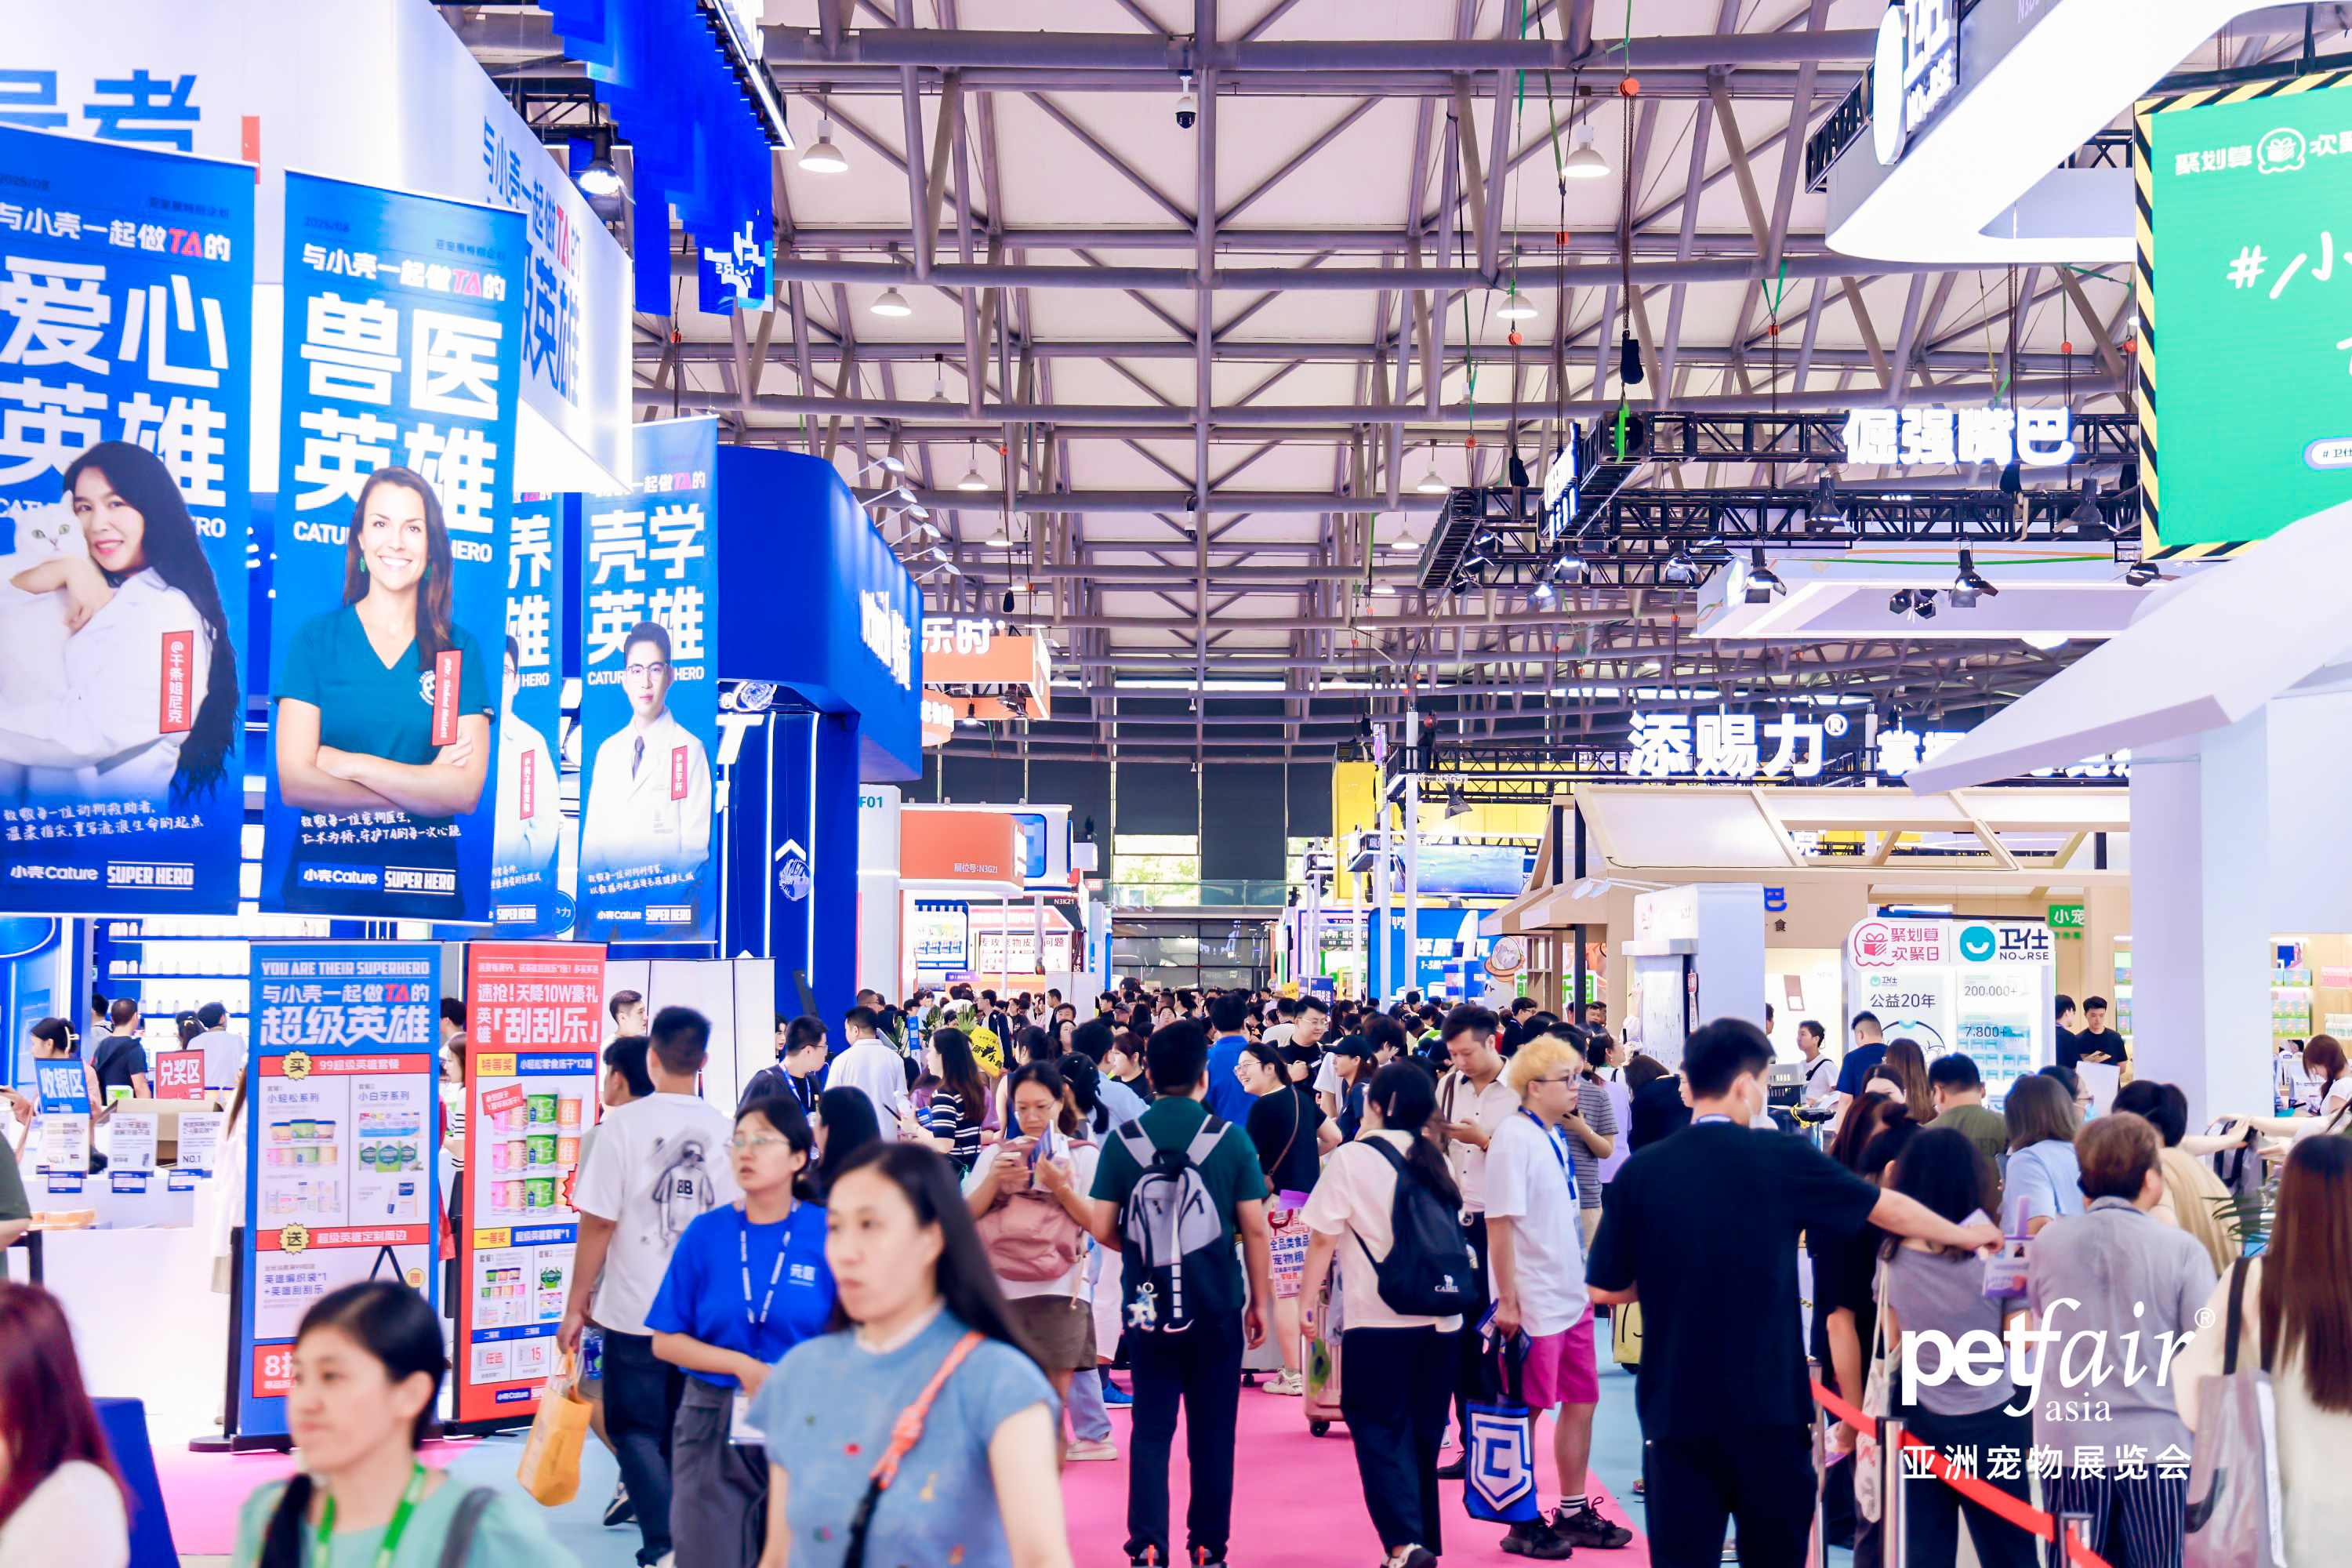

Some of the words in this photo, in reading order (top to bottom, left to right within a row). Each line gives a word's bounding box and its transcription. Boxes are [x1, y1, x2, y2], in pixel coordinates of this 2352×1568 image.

[2175, 145, 2252, 176] 聚划算
[0, 201, 231, 262] 与小壳一起做TA的
[302, 243, 506, 302] 与小壳一起做TA的
[0, 256, 230, 390] 爱心
[300, 291, 503, 420] 兽医
[1842, 406, 2075, 466] 倔强嘴巴
[294, 408, 495, 535] 英雄
[590, 503, 705, 585] 壳学
[587, 586, 705, 666] 英雄
[521, 672, 550, 687] HERO
[10, 865, 99, 880] 小壳Cature
[107, 866, 154, 884] SUPER
[155, 867, 194, 885] HERO
[303, 868, 378, 885] 小壳Cature
[384, 870, 423, 889] SUPER
[424, 873, 456, 891] HERO
[645, 909, 670, 921] SUPER
[671, 909, 691, 921] HERO
[980, 937, 1065, 947] 专攻物皮问题
[1891, 927, 1939, 942] 聚划算
[1999, 928, 2049, 950] 卫仕
[1891, 946, 1939, 961] 欢聚日
[2000, 952, 2049, 960] NOURSE
[262, 962, 289, 975] YOU
[291, 962, 315, 975] ARE
[318, 961, 354, 975] THEIR
[357, 961, 430, 975] SUPERHERO
[263, 983, 430, 1004] 与小壳一起做TA的
[477, 983, 599, 1003] 速抢！天降10W豪礼
[1870, 993, 1936, 1009] 公益20年
[260, 1005, 430, 1047] 超级英雄
[1965, 1025, 2009, 1038] 7,800+
[160, 1058, 201, 1087] 兑奖区
[290, 1058, 304, 1073] 买
[319, 1058, 400, 1071] 99超级英雄套餐
[481, 1058, 513, 1072] 特等奖
[39, 1067, 85, 1098] 收银区
[267, 1092, 320, 1104] 小轻松系列
[358, 1090, 410, 1102] 小白牙系列
[183, 1155, 201, 1163] NO.1
[287, 1232, 303, 1247] 送
[317, 1229, 407, 1244] 超级英雄定制周边
